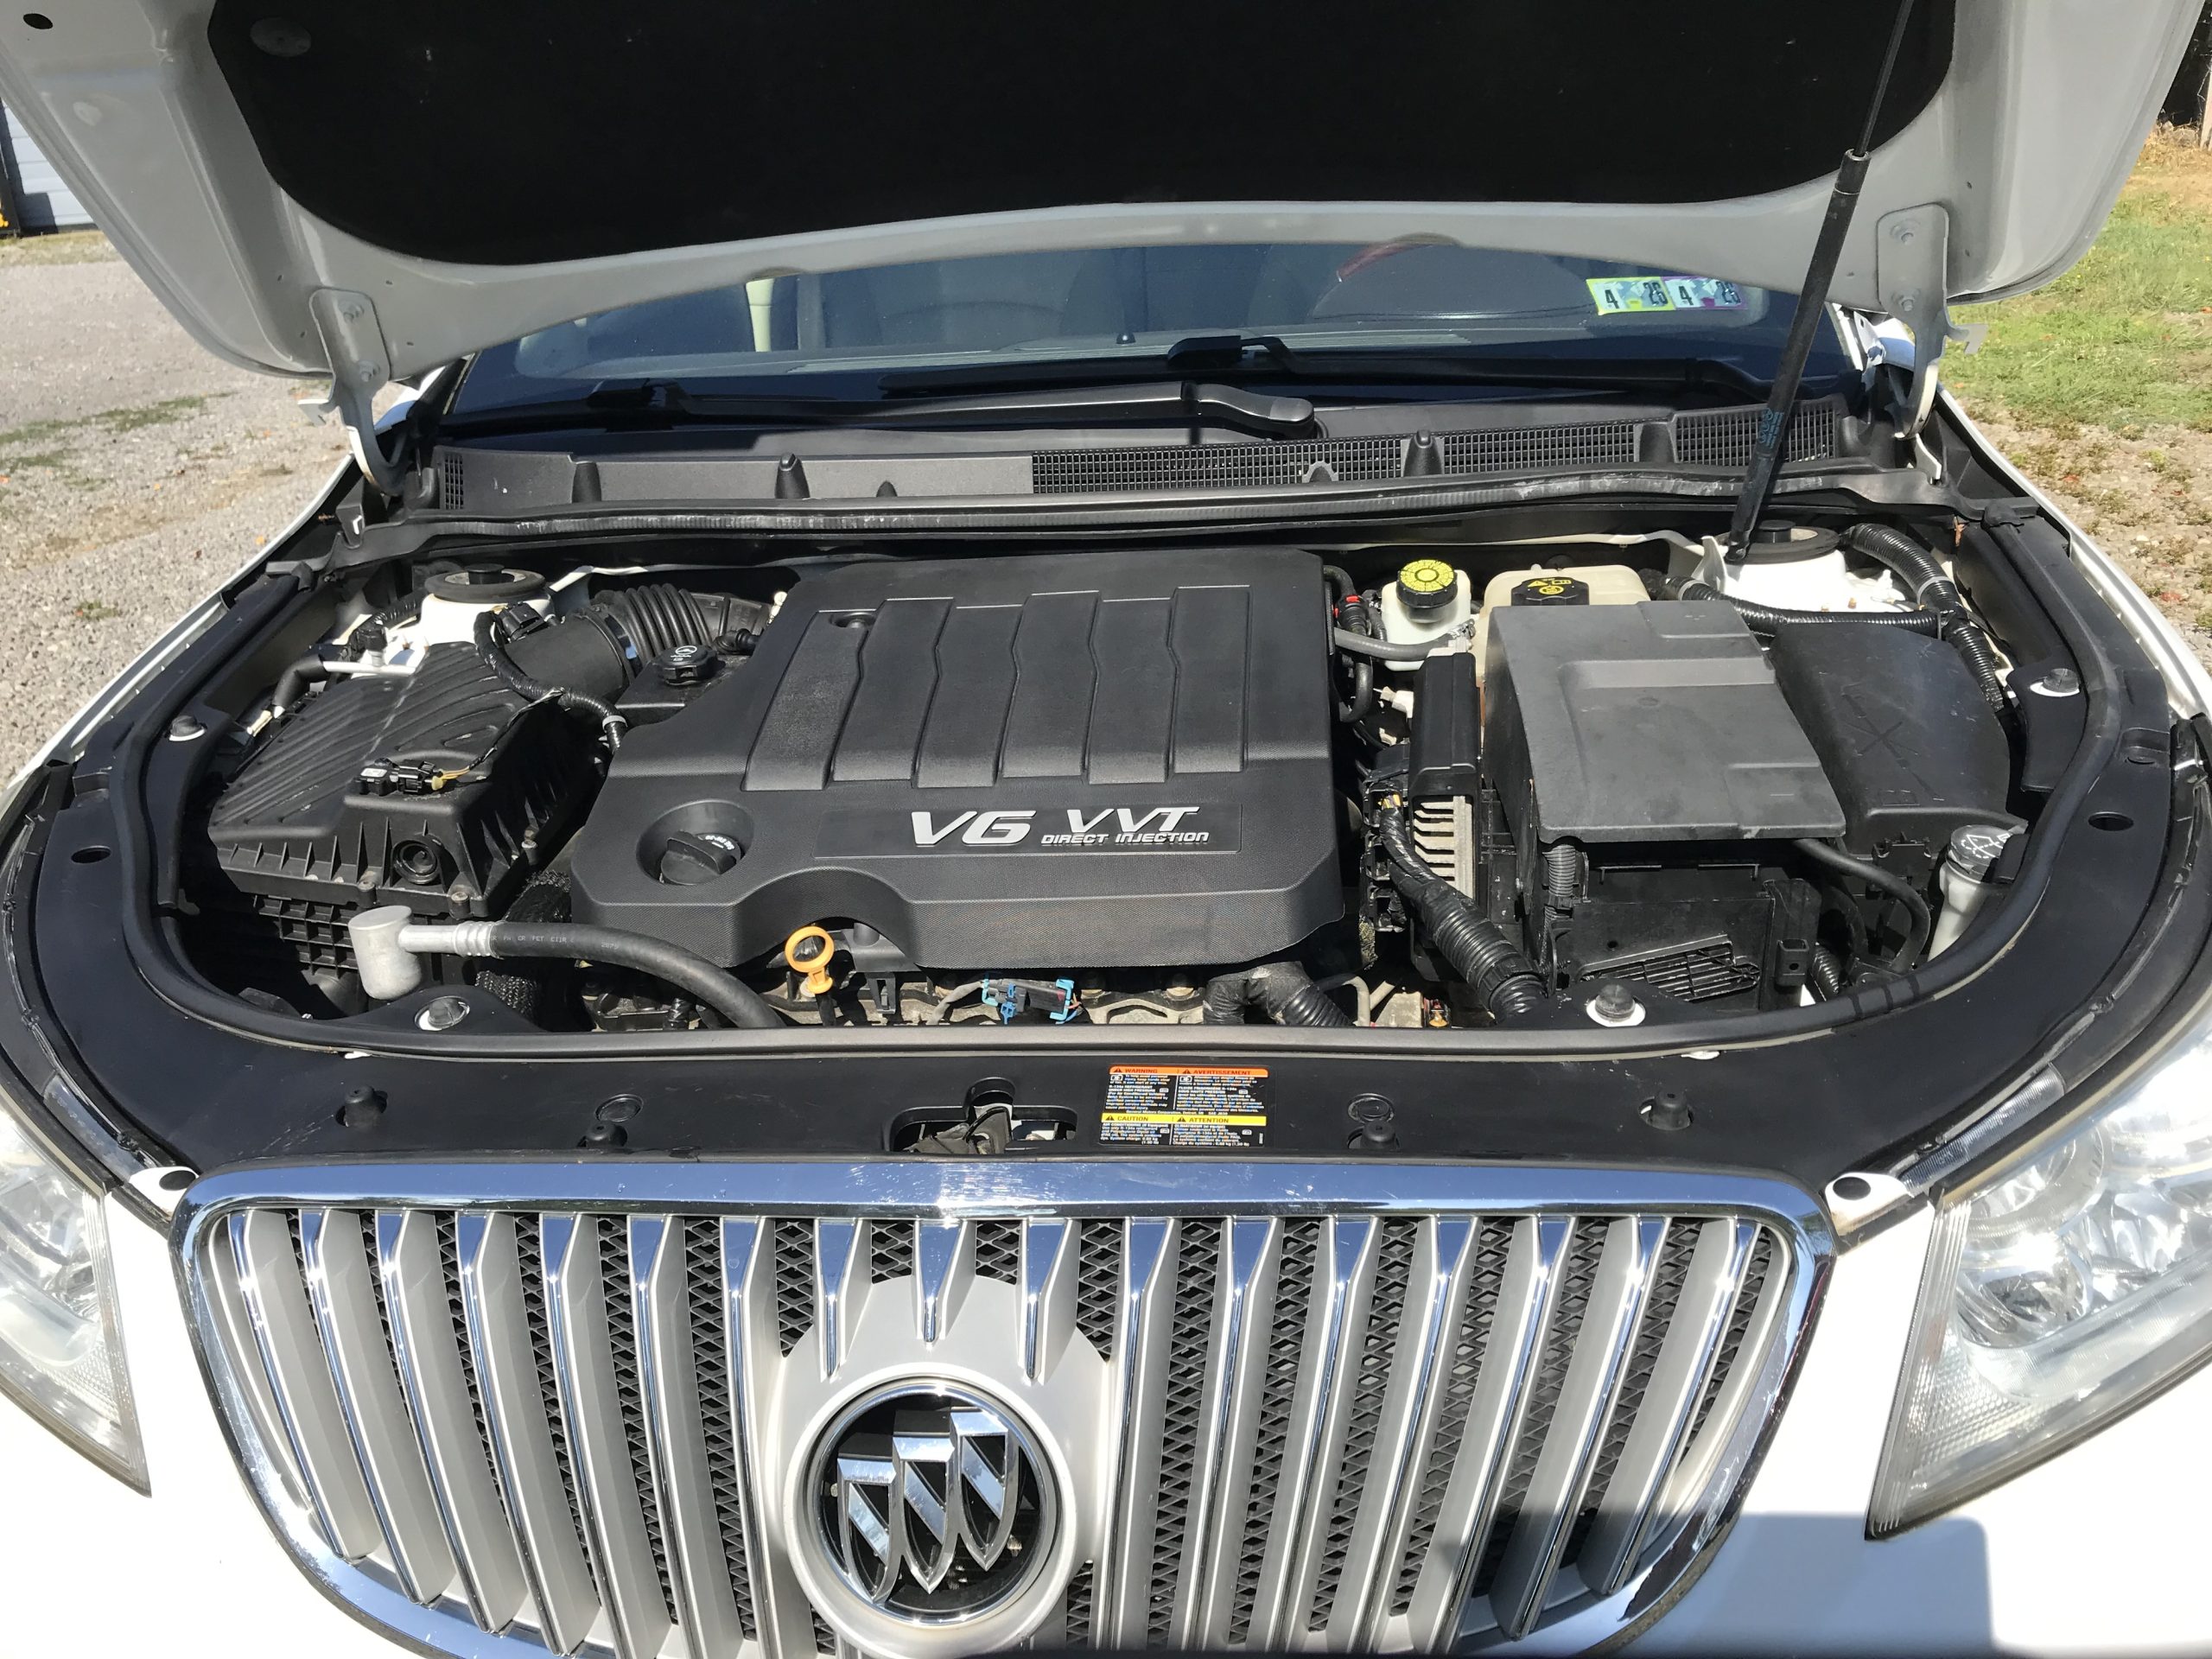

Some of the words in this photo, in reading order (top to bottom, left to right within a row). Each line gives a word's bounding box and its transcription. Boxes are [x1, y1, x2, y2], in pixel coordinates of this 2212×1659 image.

[1605, 289, 1619, 309] 4
[1679, 286, 1694, 305] 4
[911, 810, 1036, 845] V6
[1067, 806, 1200, 832] VVT
[1040, 833, 1109, 844] DIRECT
[1115, 832, 1210, 843] INJECTION
